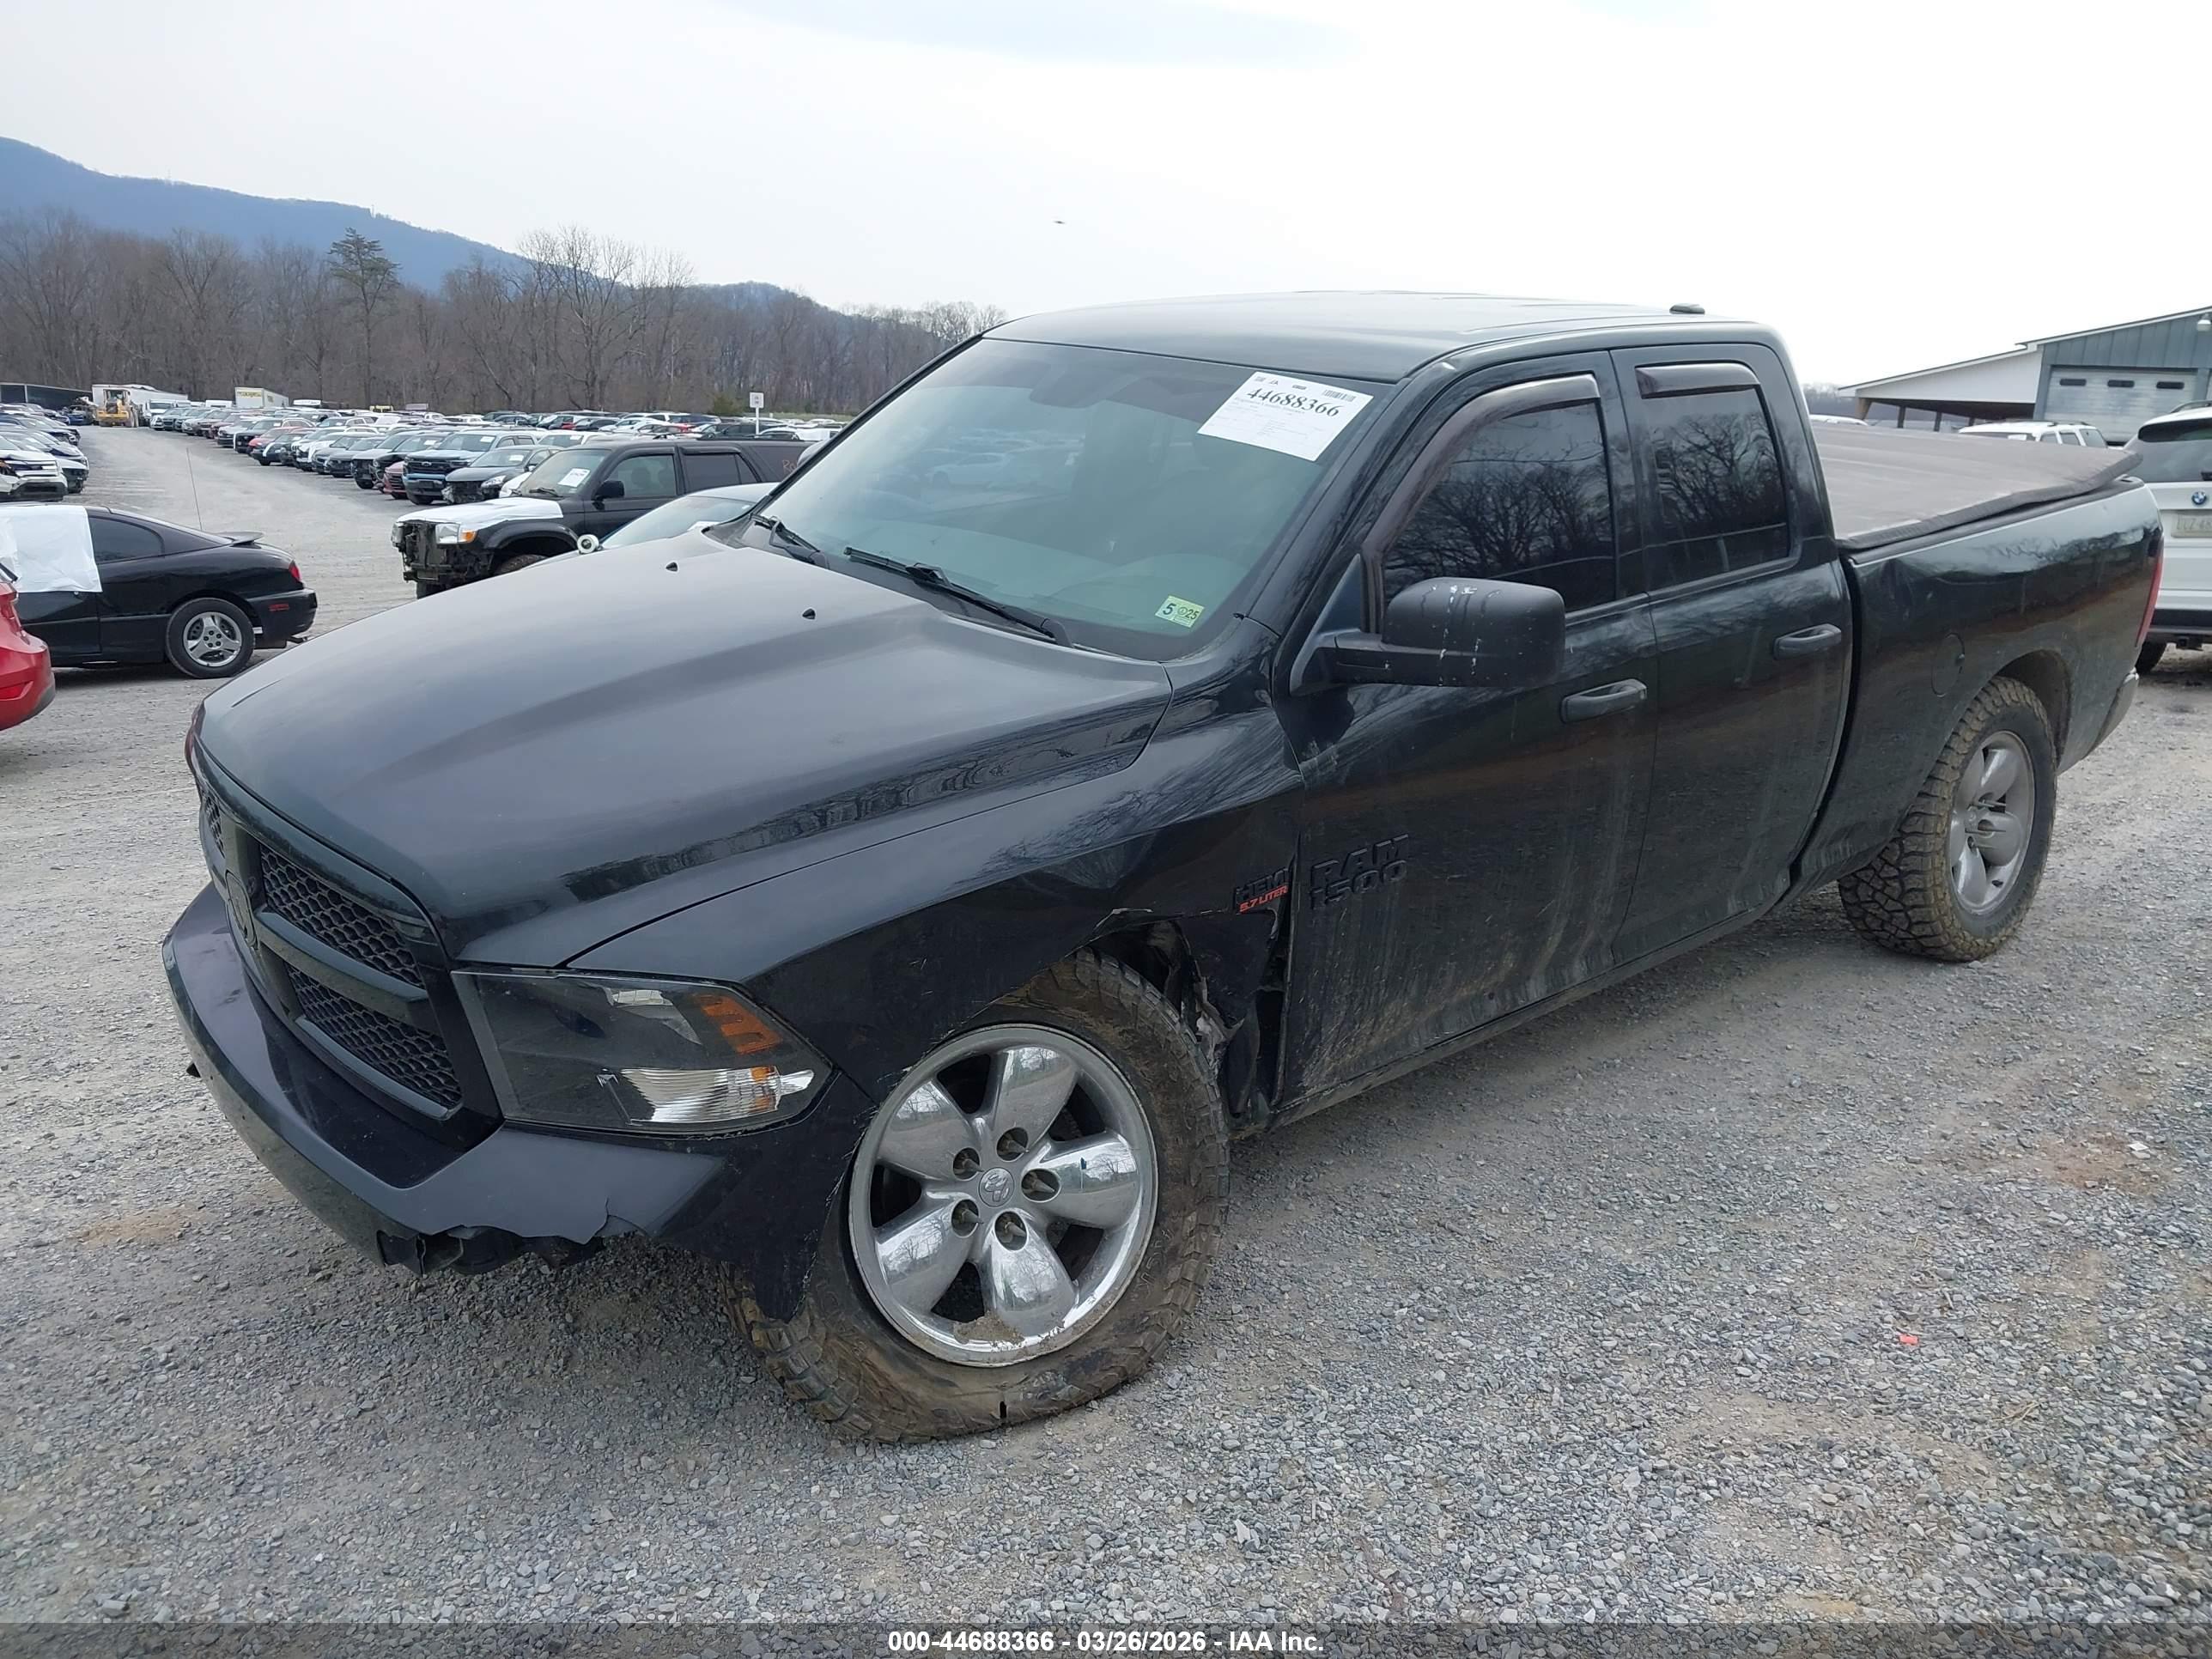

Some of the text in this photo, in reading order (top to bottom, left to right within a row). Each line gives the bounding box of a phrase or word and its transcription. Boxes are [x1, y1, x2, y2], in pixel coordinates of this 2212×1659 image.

[1247, 387, 1343, 417] 44688366
[1163, 603, 1200, 620] 5 25
[1310, 833, 1409, 889] RAM
[1259, 884, 1289, 904] LITER
[1310, 859, 1408, 910] 1500
